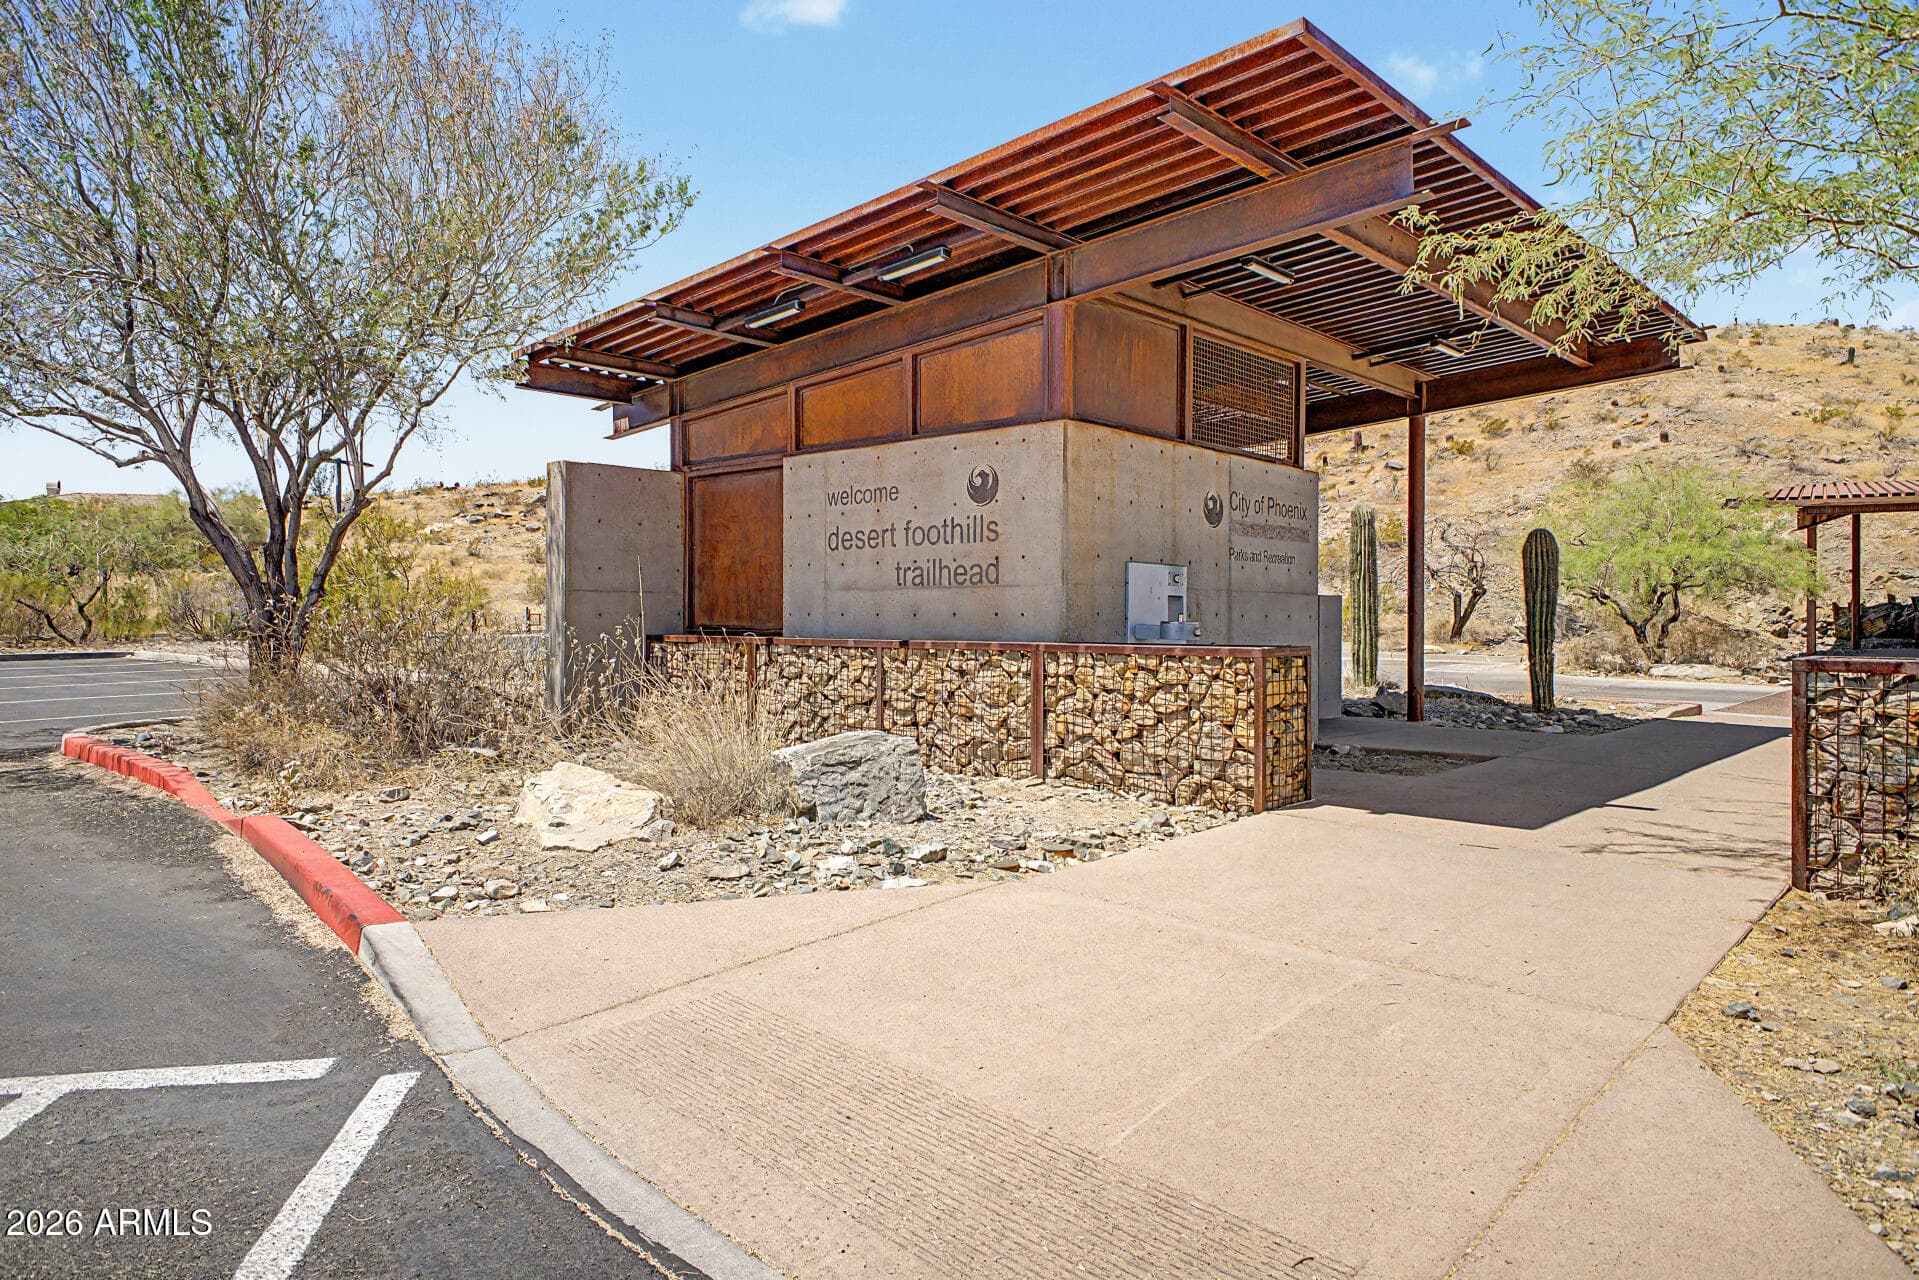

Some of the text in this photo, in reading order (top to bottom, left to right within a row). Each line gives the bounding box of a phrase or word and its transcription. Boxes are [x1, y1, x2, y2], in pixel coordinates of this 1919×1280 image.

[827, 485, 899, 506] welcome
[1229, 490, 1308, 521] City of Phoenix
[827, 514, 1000, 551] desert foothills
[1228, 546, 1296, 565] Parks and Recreation
[895, 557, 1000, 587] trailhead
